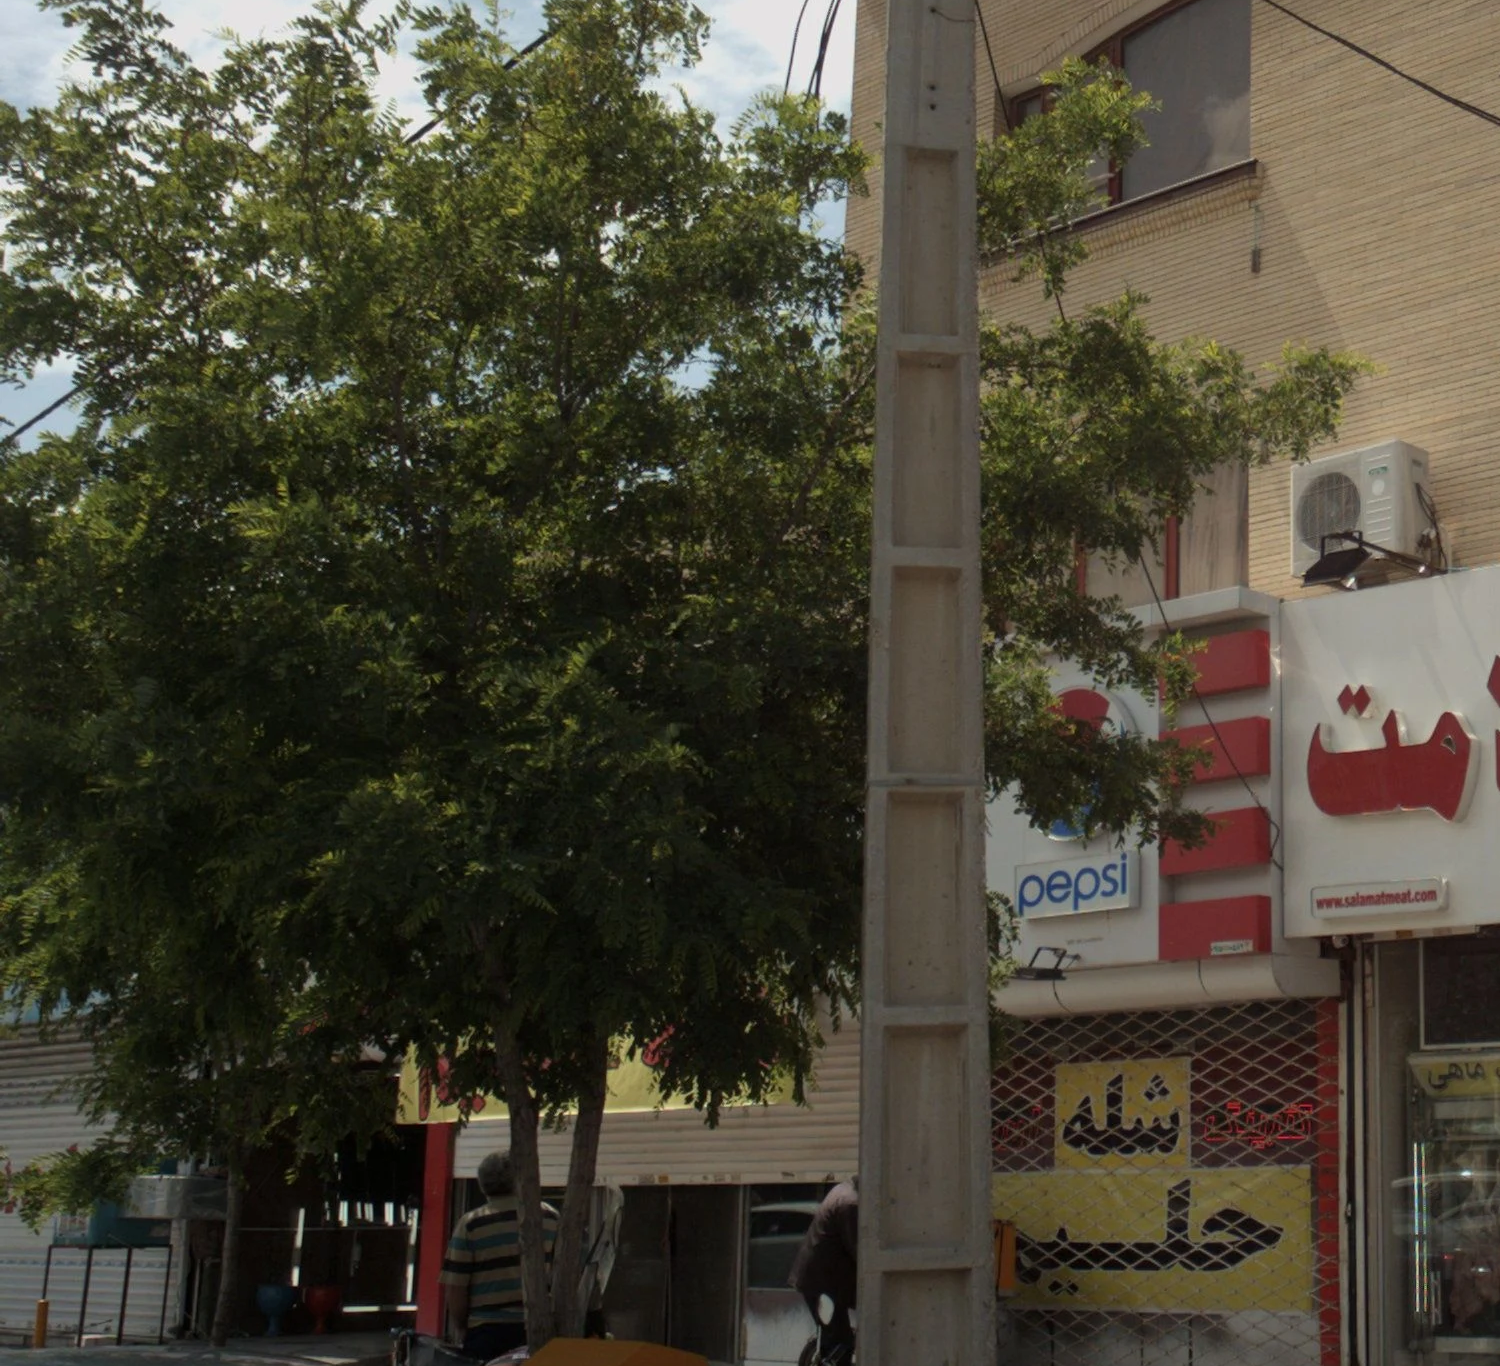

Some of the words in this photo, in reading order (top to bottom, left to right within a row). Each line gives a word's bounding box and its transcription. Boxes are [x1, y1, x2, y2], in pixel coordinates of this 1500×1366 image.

[1019, 853, 1128, 917] pepsi
[1316, 889, 1438, 910] www.salamatmeat.com
[1427, 1062, 1486, 1091] ماهی
[1062, 1073, 1181, 1156] شله
